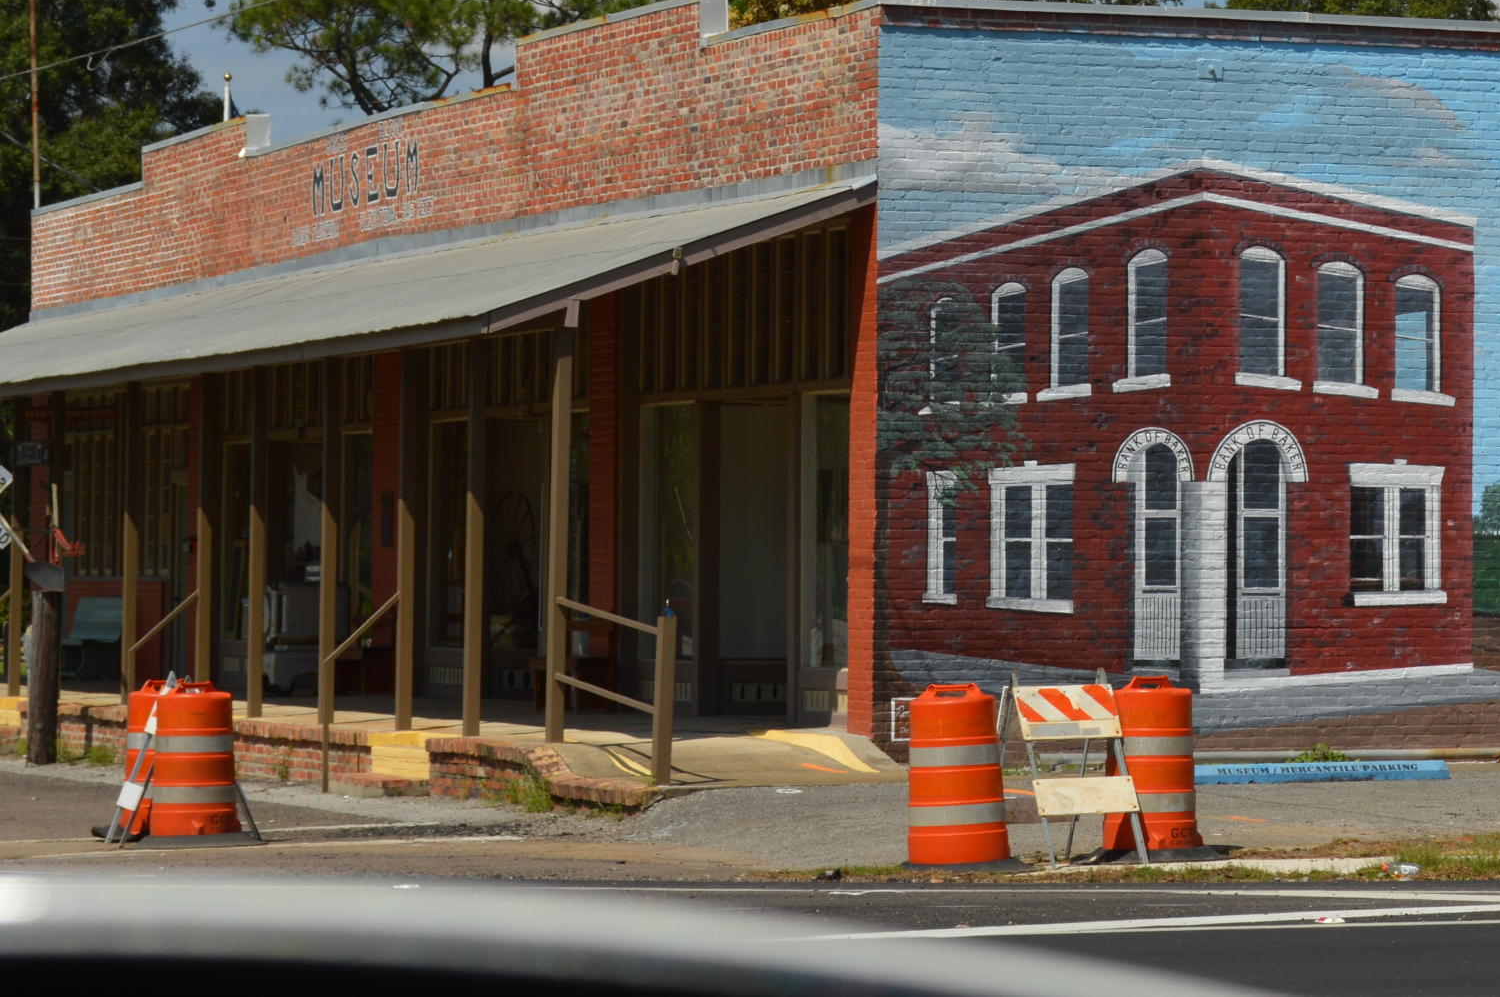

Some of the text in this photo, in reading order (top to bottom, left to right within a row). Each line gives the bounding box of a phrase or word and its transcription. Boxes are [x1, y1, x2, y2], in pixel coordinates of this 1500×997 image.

[312, 138, 419, 218] MUSEUM
[1117, 431, 1189, 473] BANK OF BAKER
[1214, 424, 1302, 471] BANK OF BAKER
[1217, 767, 1269, 776] MUSEUM
[1281, 764, 1358, 774] MERCANTILE
[1362, 763, 1419, 772] PARKING
